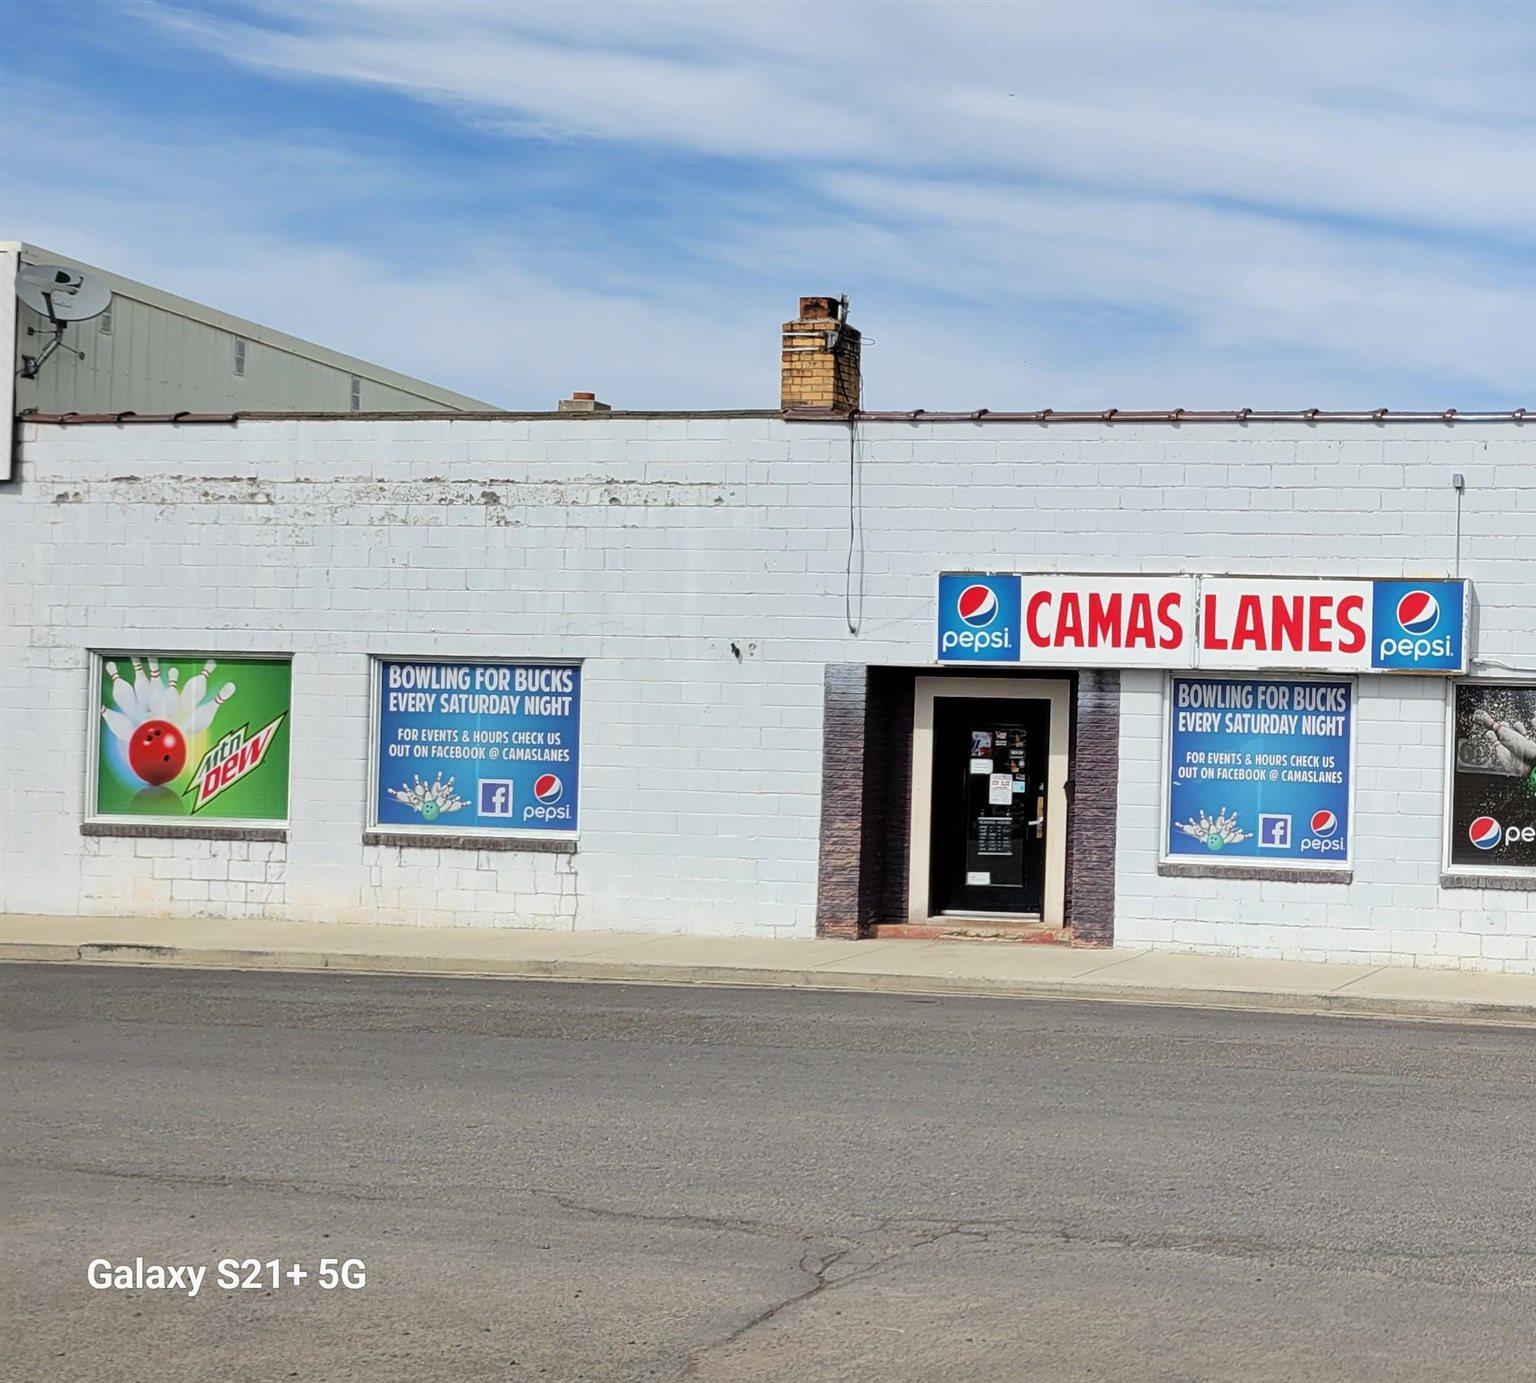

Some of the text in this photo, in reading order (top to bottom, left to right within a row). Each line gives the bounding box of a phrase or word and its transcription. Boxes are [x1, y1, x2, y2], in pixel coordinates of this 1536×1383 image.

[1026, 590, 1366, 653] CAMAS LANES
[942, 628, 1009, 652] pepsi
[1380, 634, 1451, 660] pepsi
[389, 665, 573, 693] BOWLING FOR BUCKS
[389, 692, 572, 716] EVERY SATURDAY NIGHT
[1178, 684, 1346, 712] BOWLING FOR BUCKS
[1178, 712, 1345, 736] EVERY SATURDAY NIGHT
[398, 728, 561, 745] FOR EVENTS & HOURS CHECK US
[389, 744, 570, 762] OUT ON FACEBOOK @ CAMASLANES
[1186, 751, 1335, 768] FOR EVENTS & HOURS CHECK US
[1178, 766, 1342, 784] OUT ON FACEBOOK @ CAMASLANES
[492, 786, 506, 813] f
[523, 804, 570, 823] pepsi
[1272, 821, 1284, 844] f
[1301, 837, 1344, 853] pepsi
